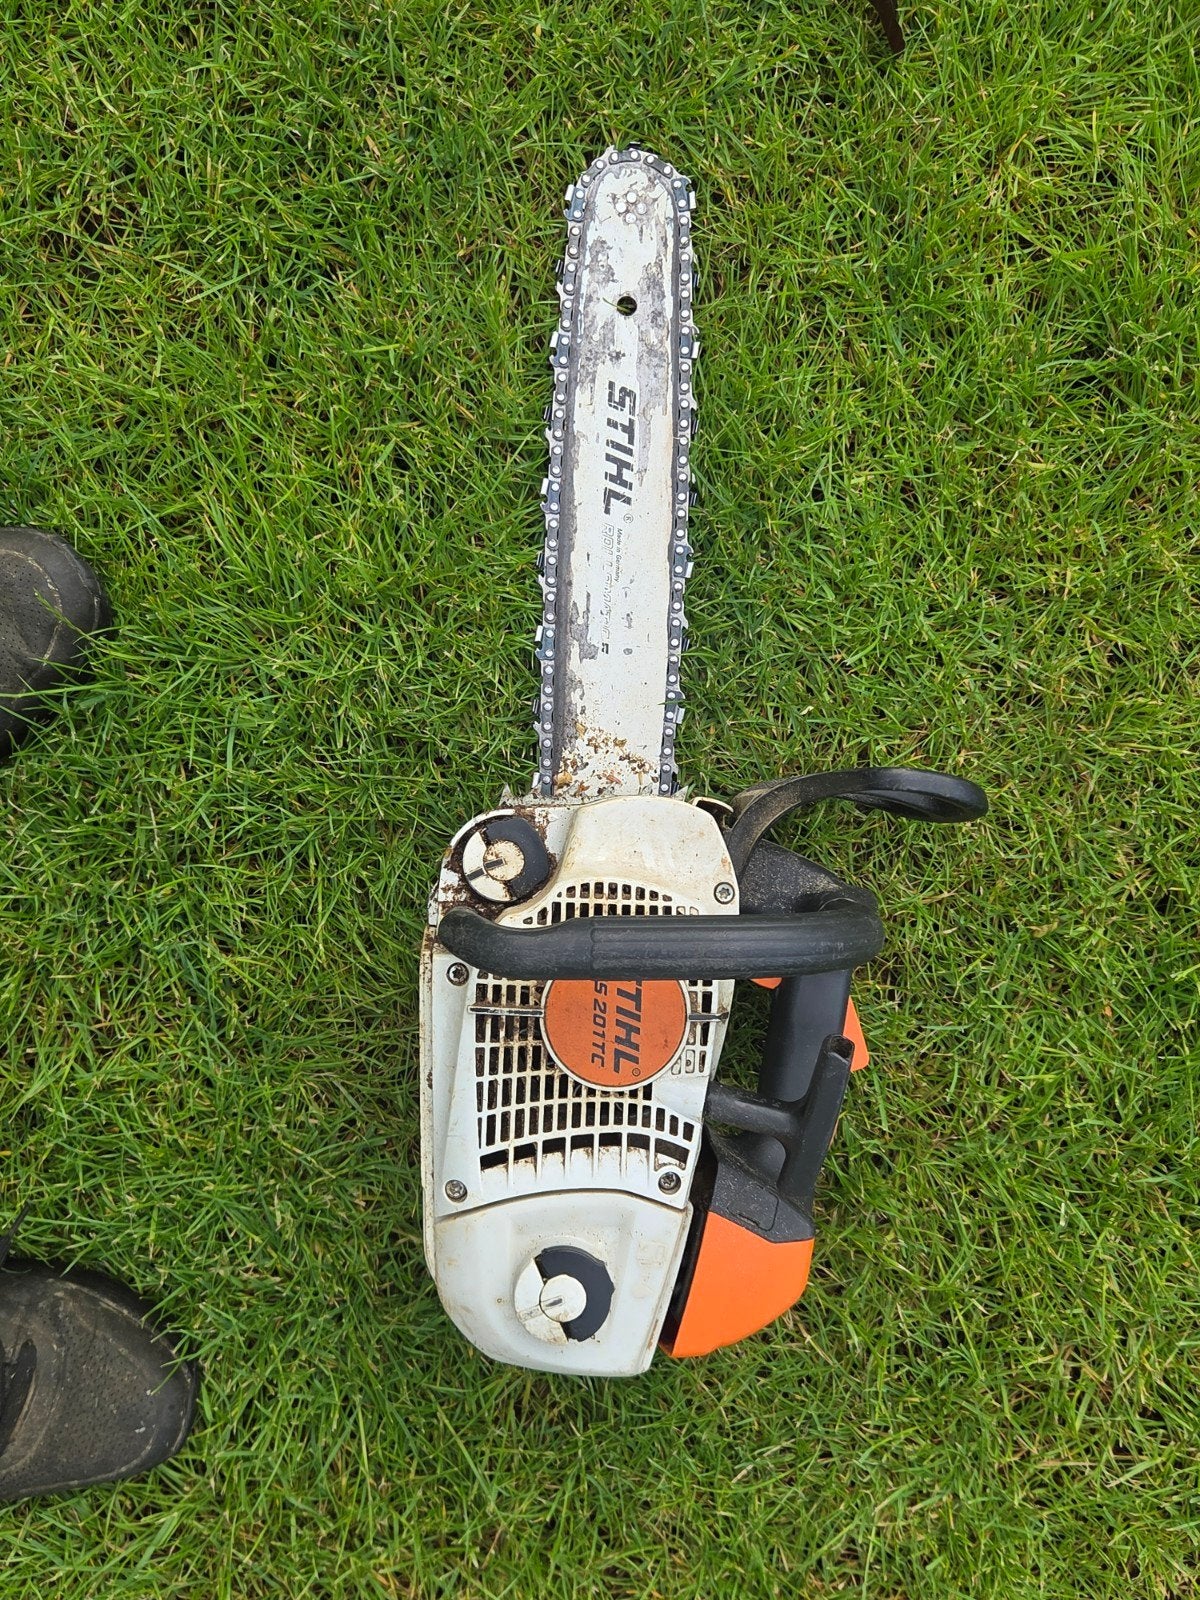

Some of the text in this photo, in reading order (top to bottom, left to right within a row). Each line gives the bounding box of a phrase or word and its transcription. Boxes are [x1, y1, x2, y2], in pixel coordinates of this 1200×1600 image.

[603, 380, 636, 515] STIHL
[615, 527, 623, 546] Made
[613, 554, 623, 583] Germany
[594, 980, 608, 997] S
[613, 980, 643, 1074] TIHL
